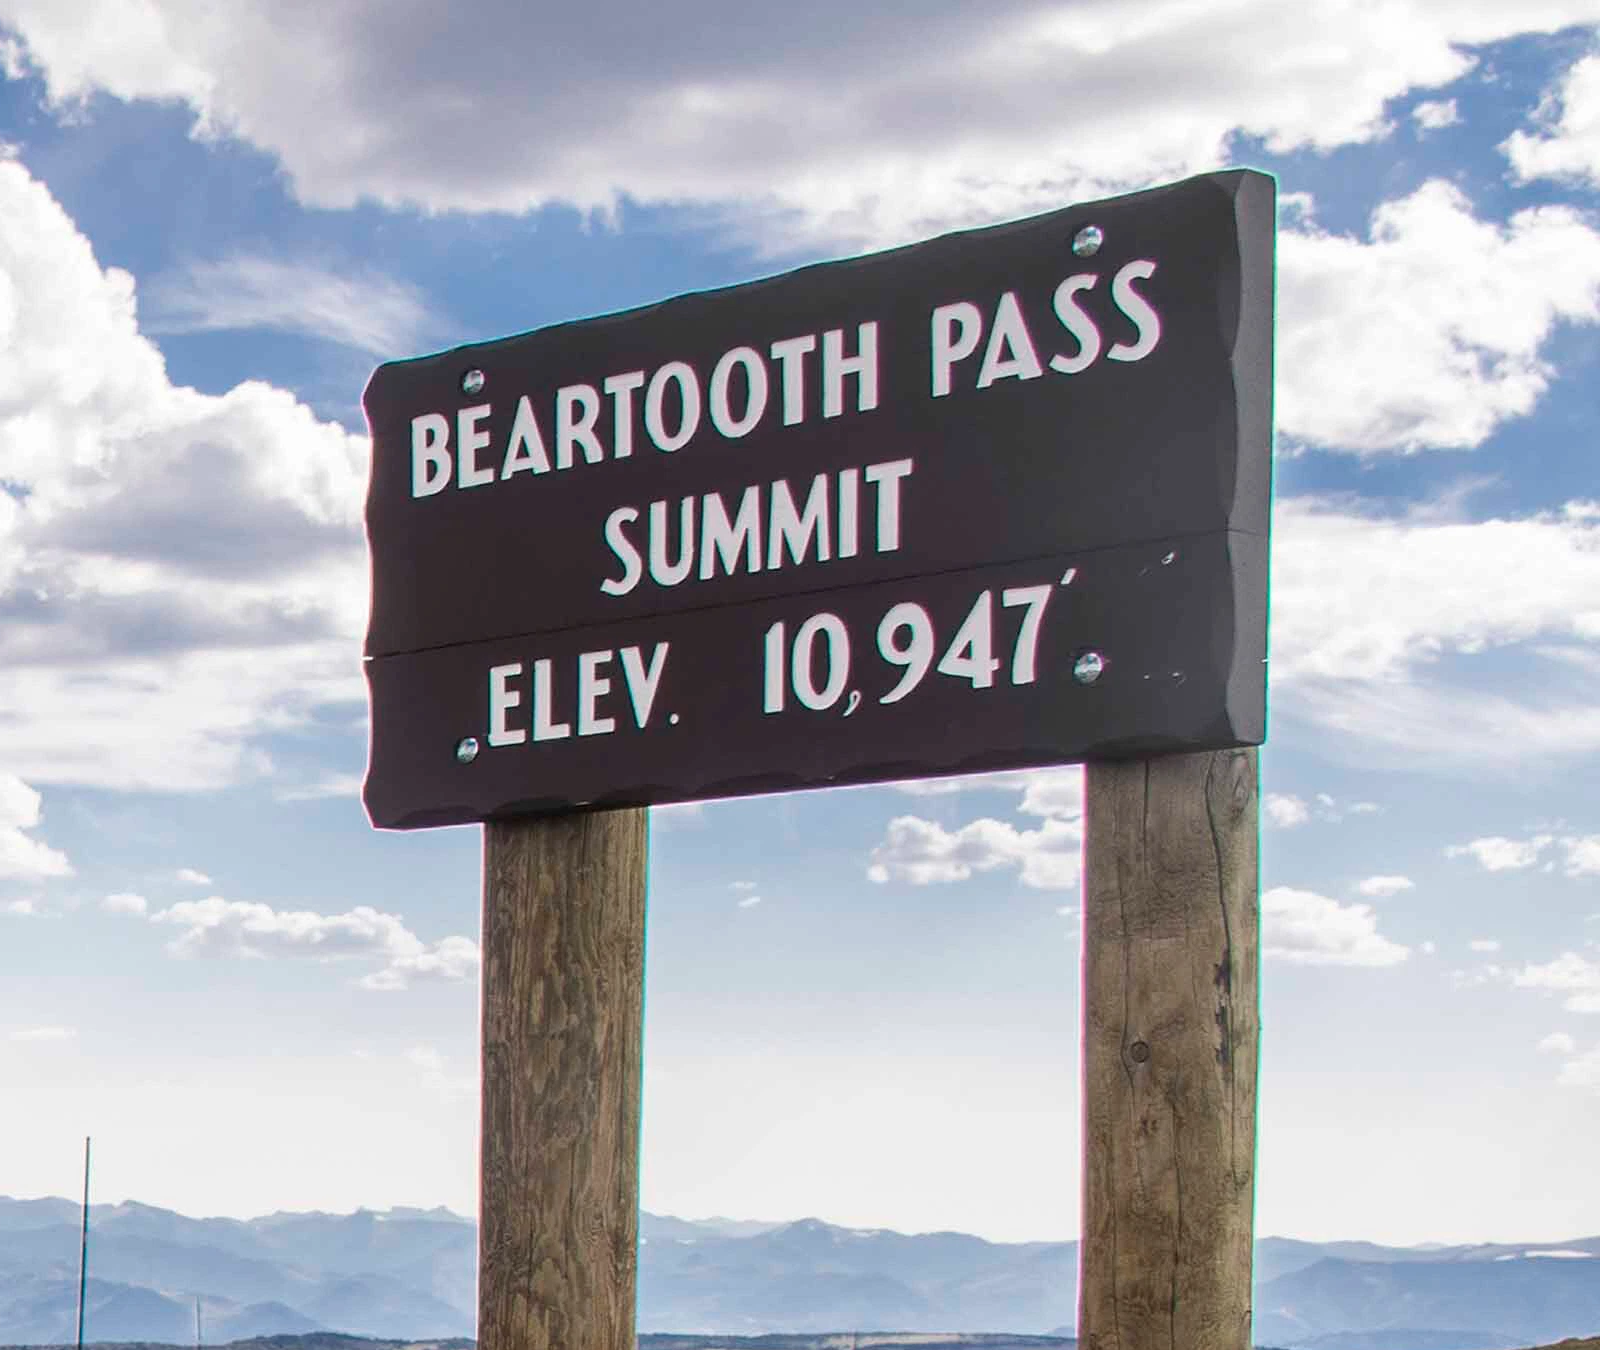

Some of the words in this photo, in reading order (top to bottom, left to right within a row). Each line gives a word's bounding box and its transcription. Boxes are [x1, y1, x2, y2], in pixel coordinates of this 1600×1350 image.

[411, 321, 878, 498] BEARTOOTH
[931, 259, 1161, 398] PASS
[600, 458, 913, 596] SUMMIT
[487, 642, 679, 747] ELEV.
[764, 568, 1077, 717] 10,947'
